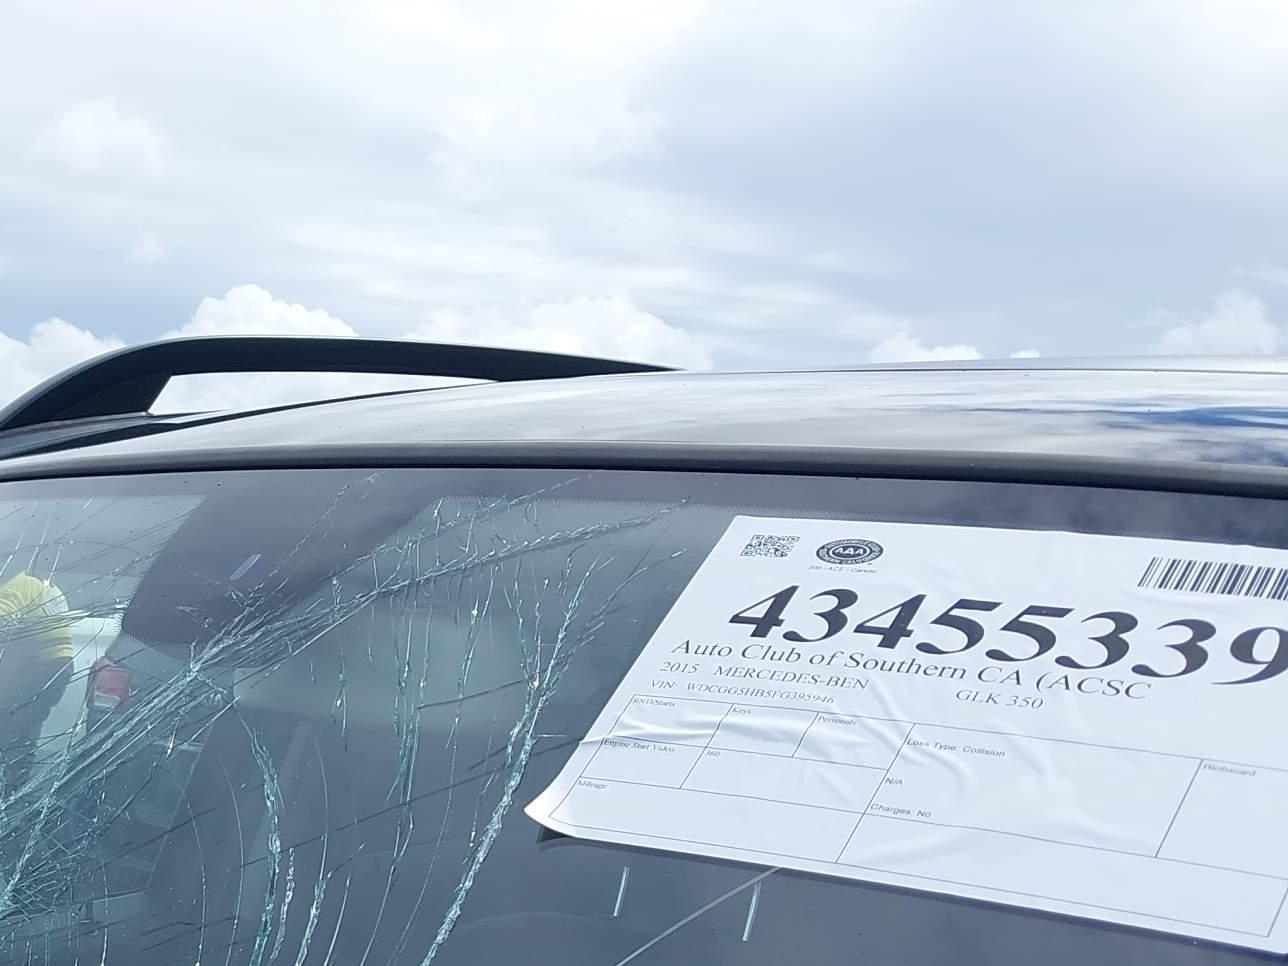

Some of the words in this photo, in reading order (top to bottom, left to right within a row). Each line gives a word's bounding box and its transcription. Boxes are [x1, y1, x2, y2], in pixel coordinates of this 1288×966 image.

[834, 546, 865, 556] AAA
[728, 585, 1288, 685] 43455339
[659, 661, 700, 674] 2015
[713, 665, 870, 690] MERCEDES-BEN
[671, 639, 733, 658] Auto
[741, 644, 801, 663] Club
[809, 651, 844, 671] of
[844, 652, 967, 680] Southern
[977, 666, 1022, 686] CA
[1035, 672, 1152, 700] (ACSC
[651, 679, 678, 690] VIN:
[955, 689, 1002, 705] GLK
[1006, 694, 1044, 710] 350
[732, 707, 752, 715] Keys
[632, 742, 650, 751] Start
[907, 738, 930, 747] Loss
[963, 745, 1006, 758] Collision
[885, 777, 903, 786] N/A
[870, 803, 912, 815] Charges:
[916, 809, 931, 818] No
